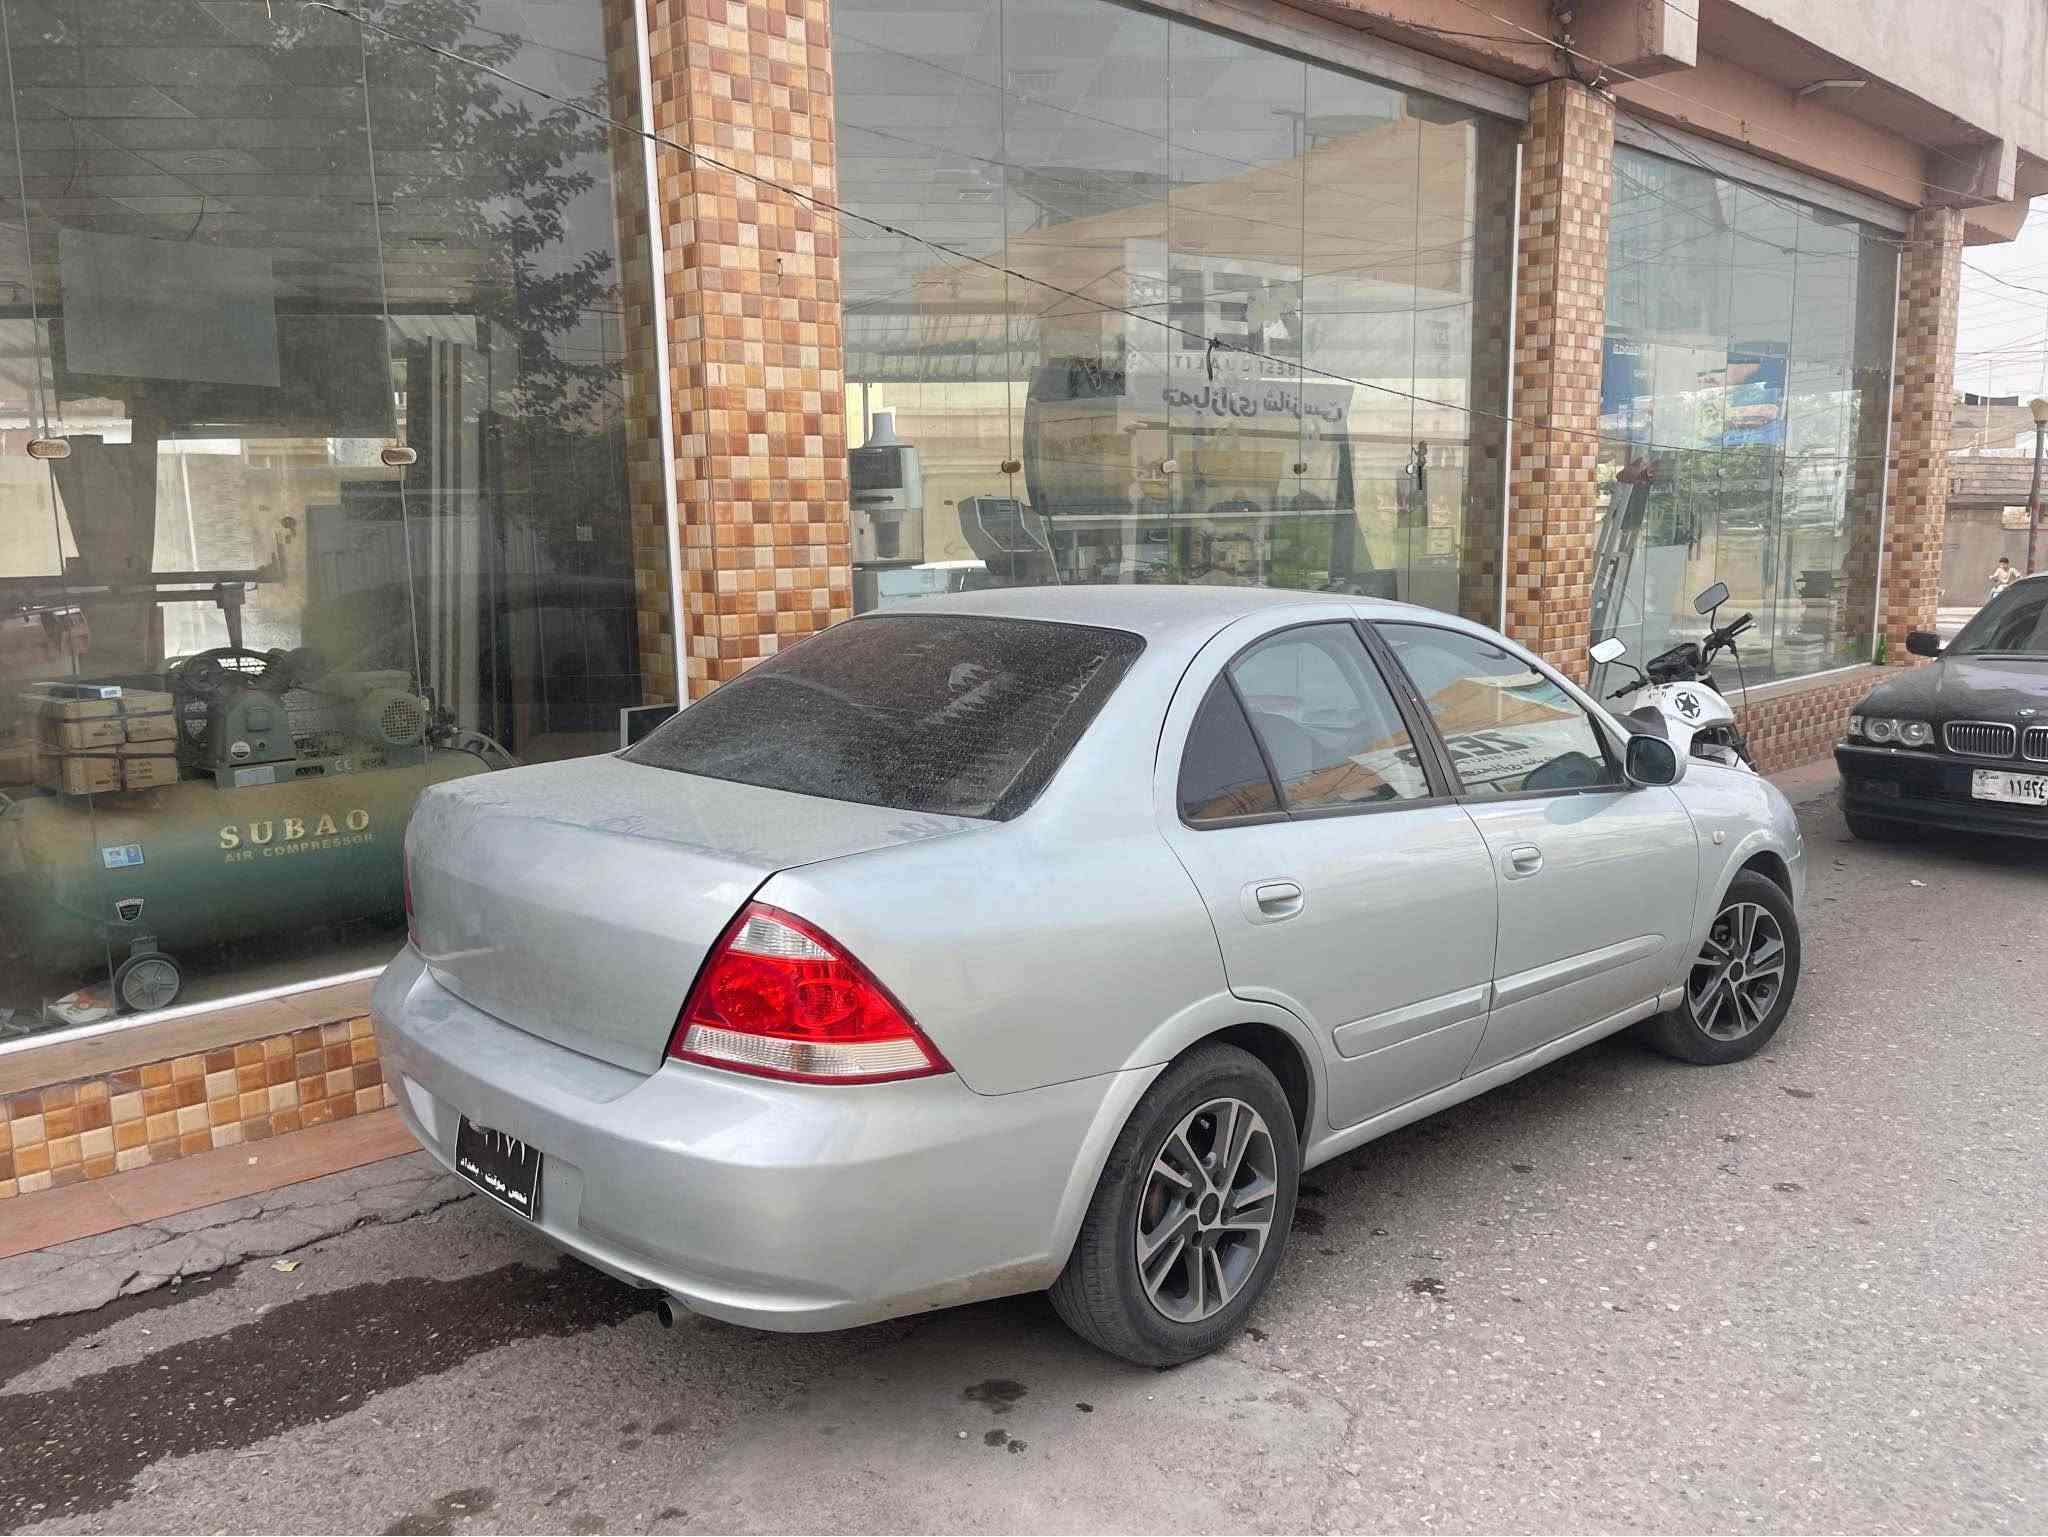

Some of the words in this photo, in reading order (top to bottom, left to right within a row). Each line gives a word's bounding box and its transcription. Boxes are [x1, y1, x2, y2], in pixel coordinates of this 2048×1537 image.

[219, 809, 370, 850] SUBAO
[225, 850, 255, 864] AIR
[263, 833, 376, 858] COMPRESSOR
